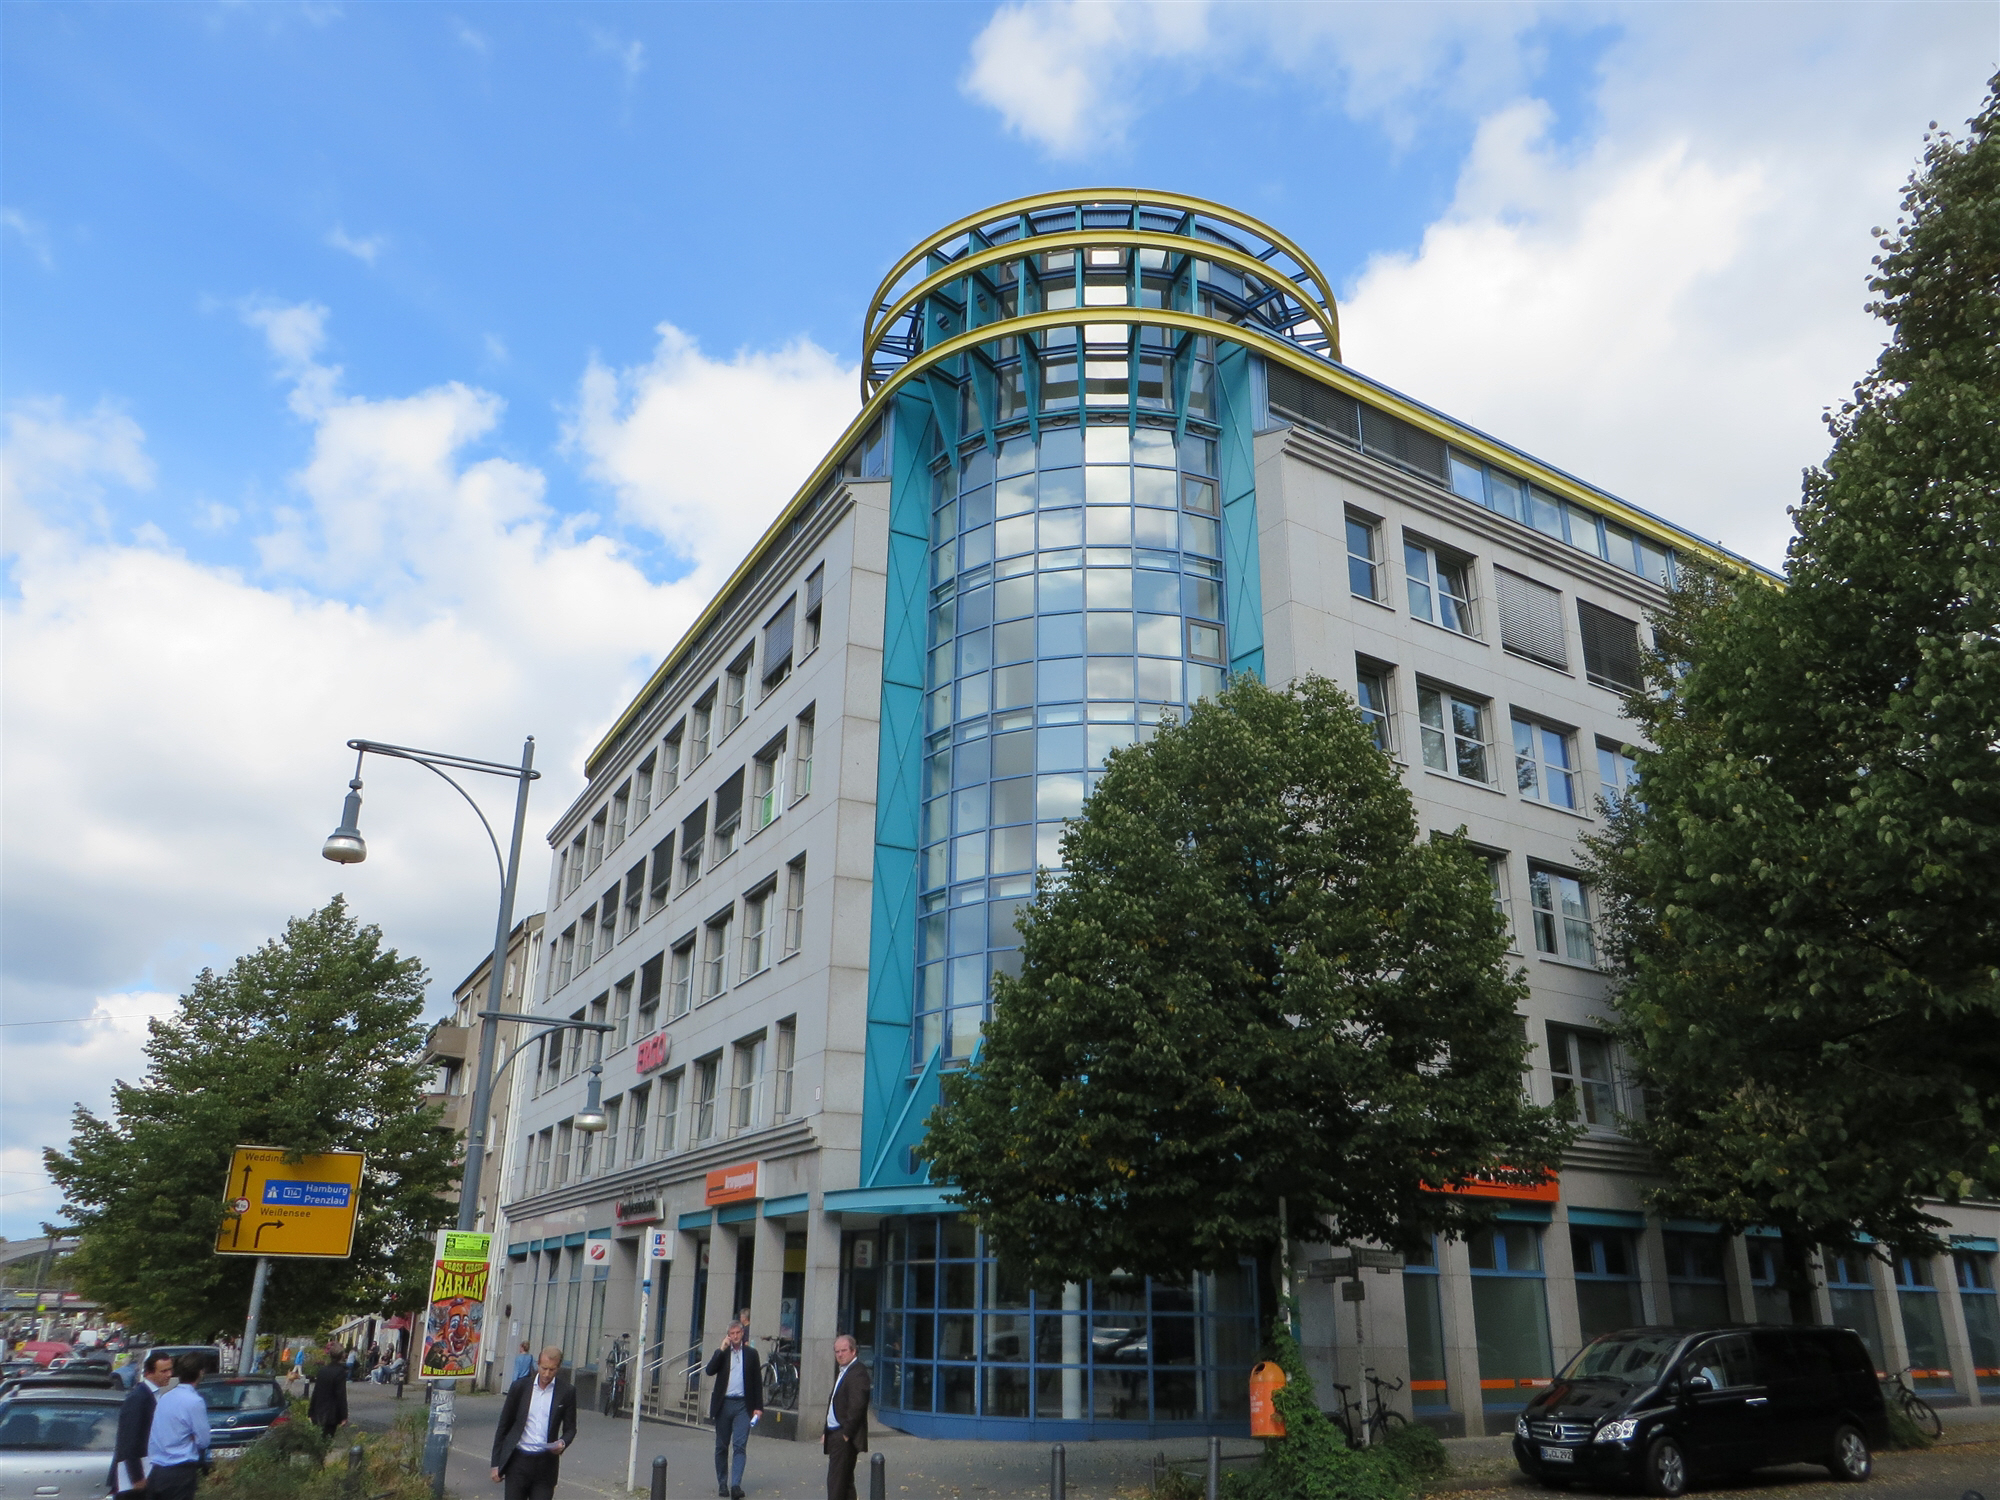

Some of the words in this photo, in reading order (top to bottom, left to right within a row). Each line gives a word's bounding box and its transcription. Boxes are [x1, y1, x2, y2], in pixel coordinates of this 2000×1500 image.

[637, 1032, 667, 1073] ERGO
[245, 1152, 285, 1164] Wedding
[306, 1184, 348, 1196] Hamburg
[304, 1195, 345, 1205] Prenzlau
[260, 1208, 311, 1218] Weißensee
[444, 1261, 463, 1273] GROSS
[432, 1267, 488, 1302] BARLAY
[433, 1367, 447, 1375] WELT
